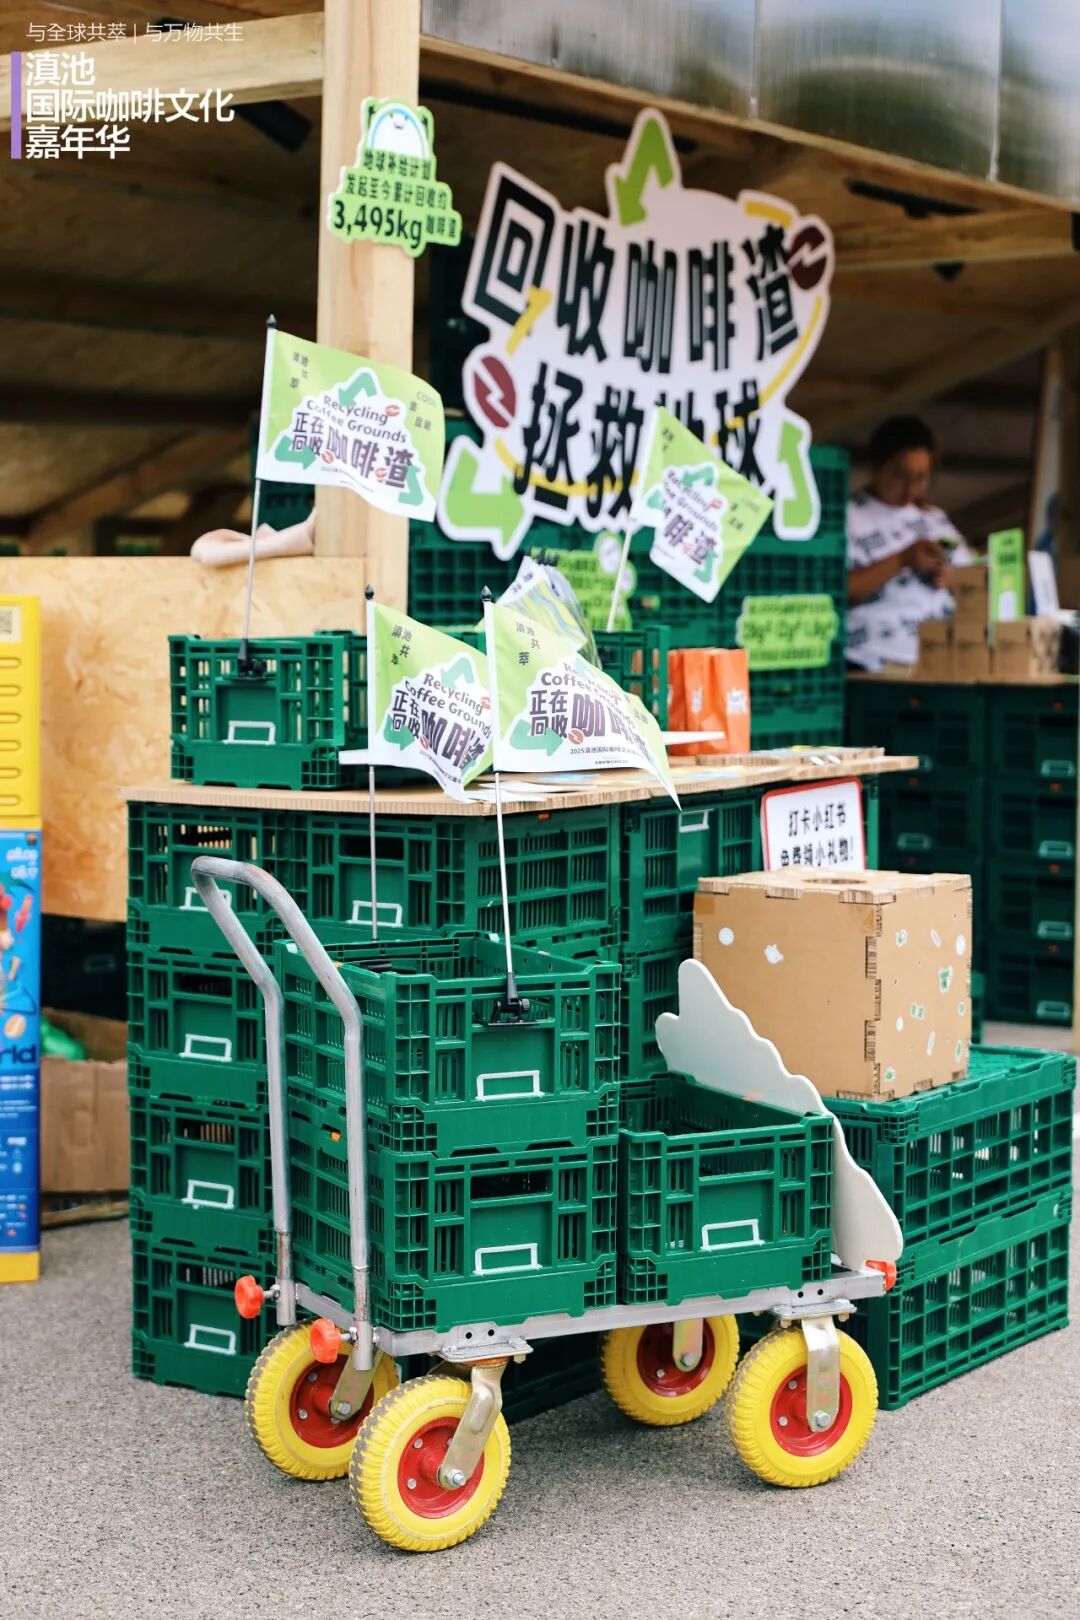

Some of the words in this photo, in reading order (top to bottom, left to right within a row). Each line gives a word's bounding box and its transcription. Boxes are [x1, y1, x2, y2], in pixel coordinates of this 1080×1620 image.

[333, 200, 423, 249] 3,495kg
[473, 174, 799, 374] 回收咖啡渣
[293, 411, 324, 434] 正在
[306, 399, 344, 426] Coffee
[347, 419, 407, 443] Grounds
[324, 395, 388, 426] Recycling
[292, 434, 324, 456] 回收
[327, 426, 414, 489] 咖啡渣
[392, 689, 419, 719] 正在
[405, 680, 445, 708] Coffee
[423, 673, 484, 716] Recycling
[529, 689, 569, 715] 正在
[393, 713, 420, 739] 回收
[530, 714, 569, 739] 回收
[788, 801, 846, 837] 打卡小红书
